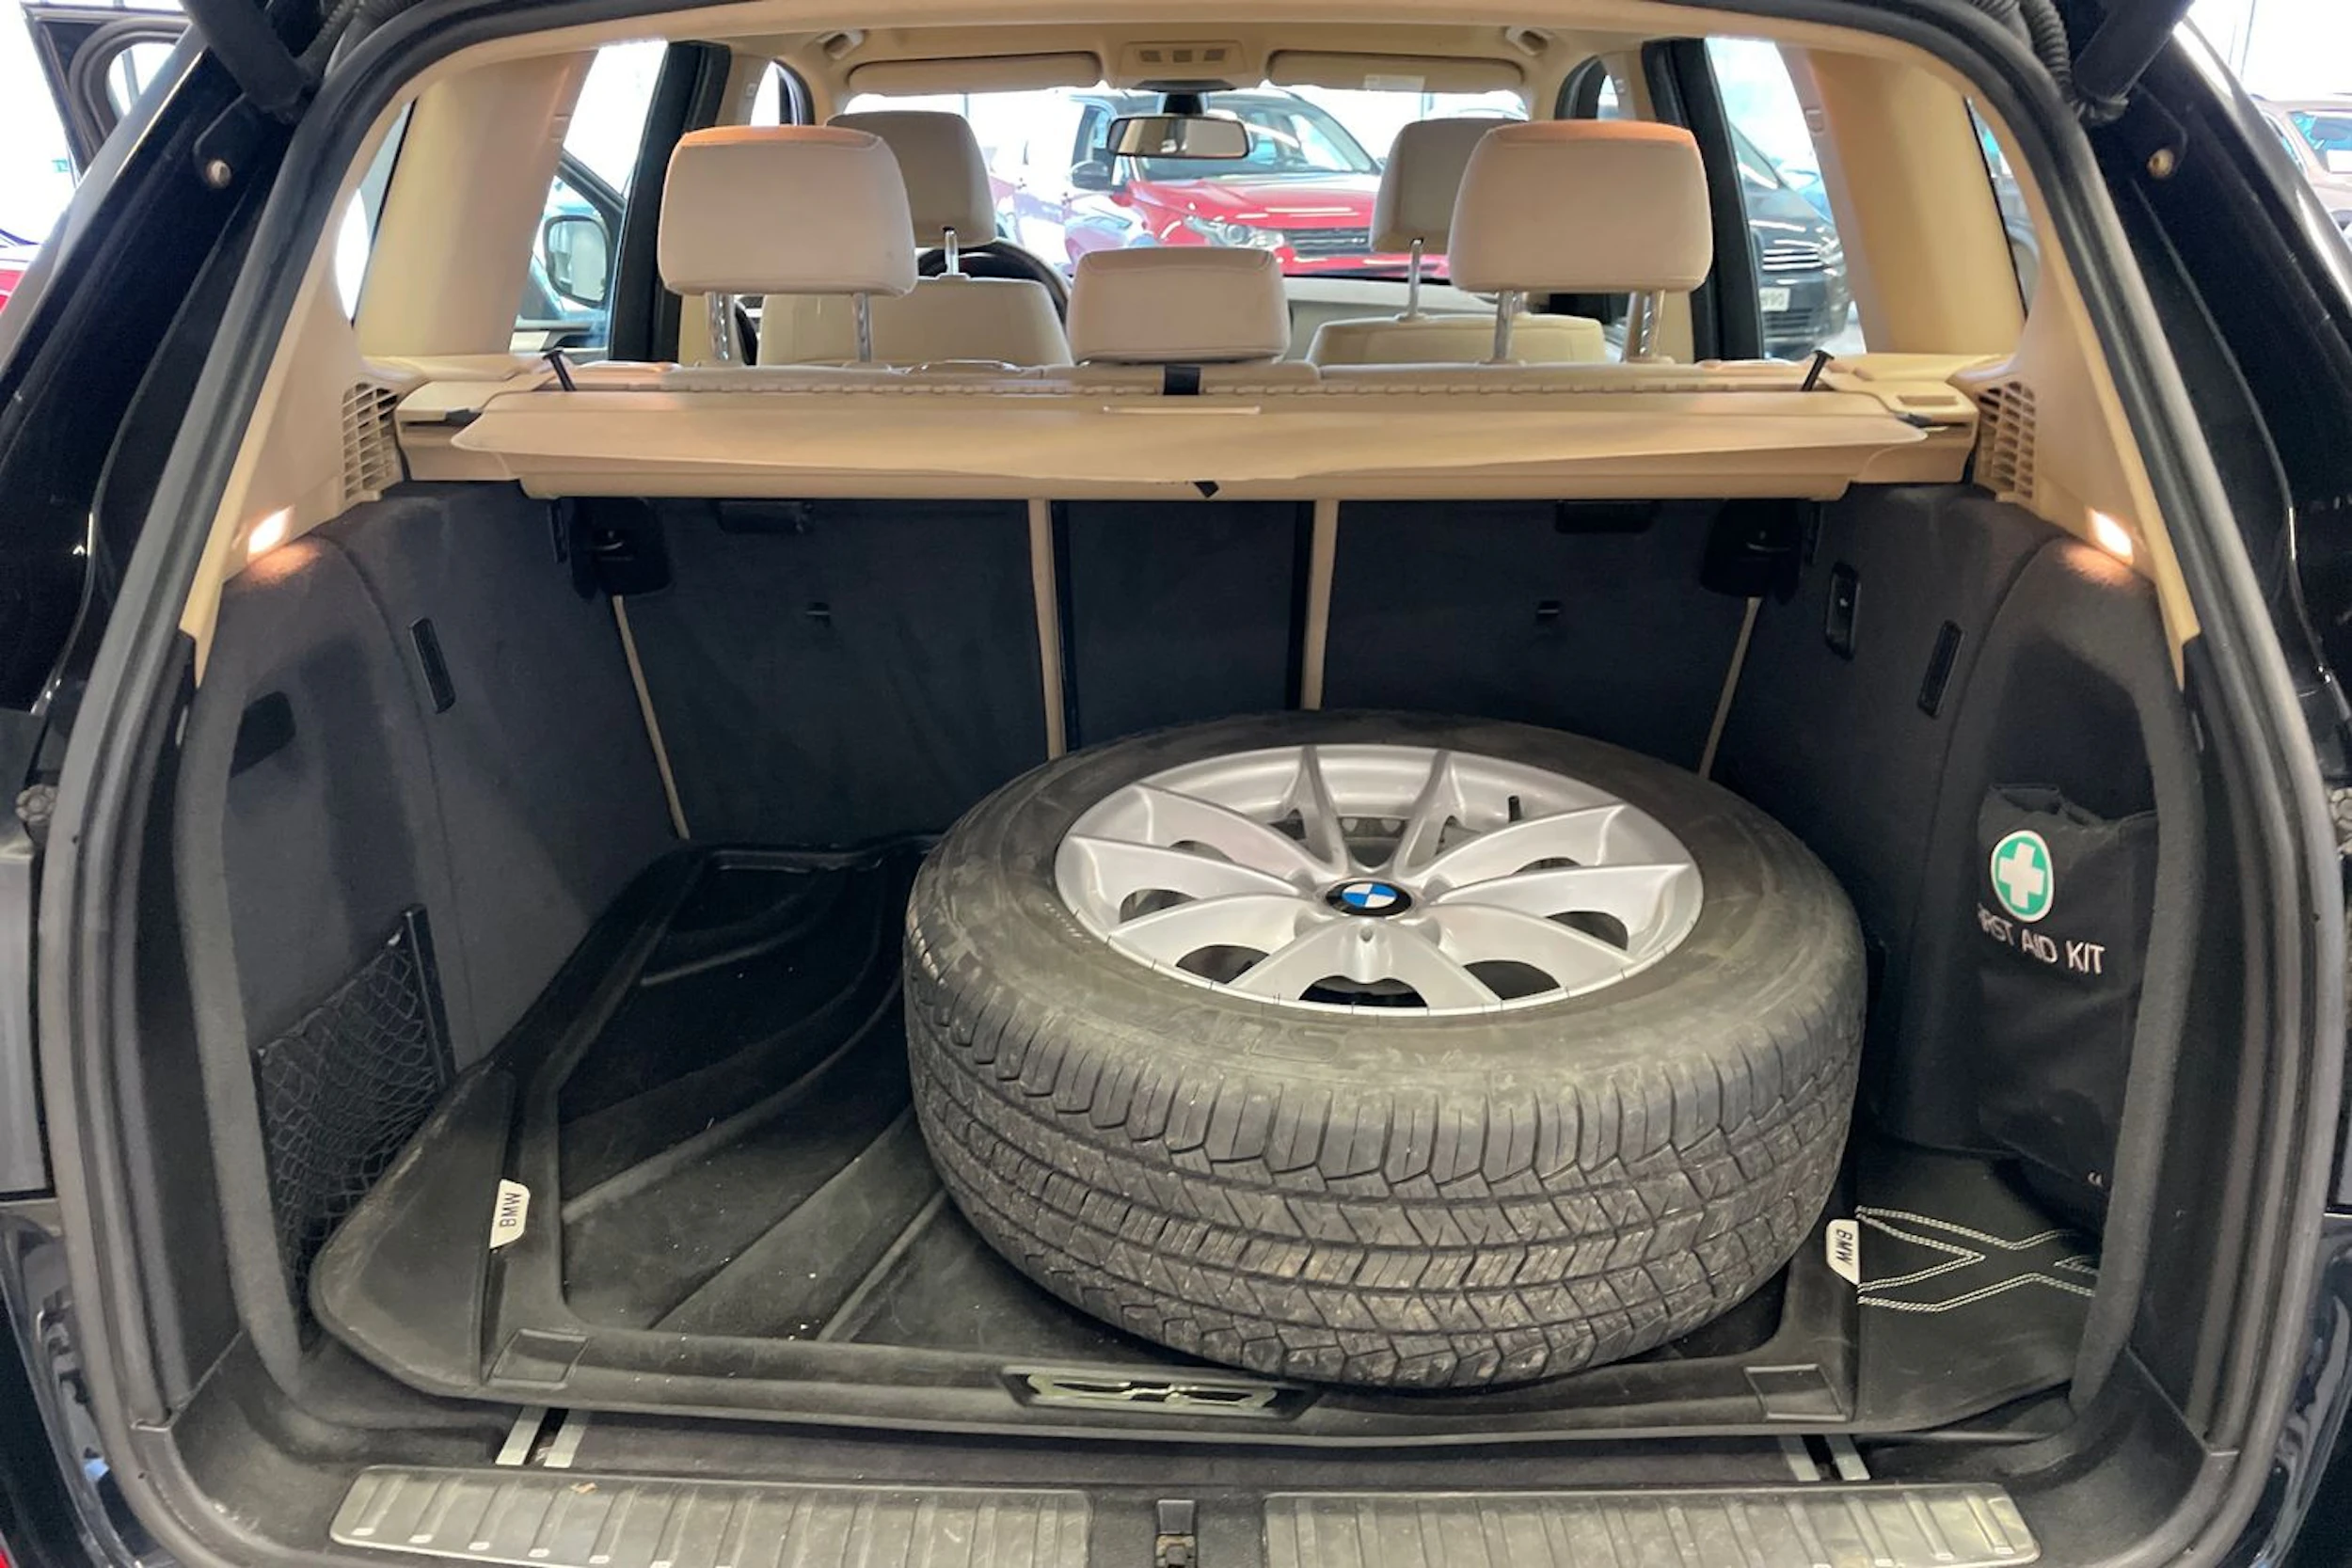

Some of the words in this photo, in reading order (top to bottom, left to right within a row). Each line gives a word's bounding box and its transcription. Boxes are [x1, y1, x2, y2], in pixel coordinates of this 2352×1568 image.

[2021, 928, 2058, 964] AID
[2066, 940, 2106, 974] KIT
[499, 1192, 522, 1227] BMW
[1836, 1228, 1853, 1266] BMW
